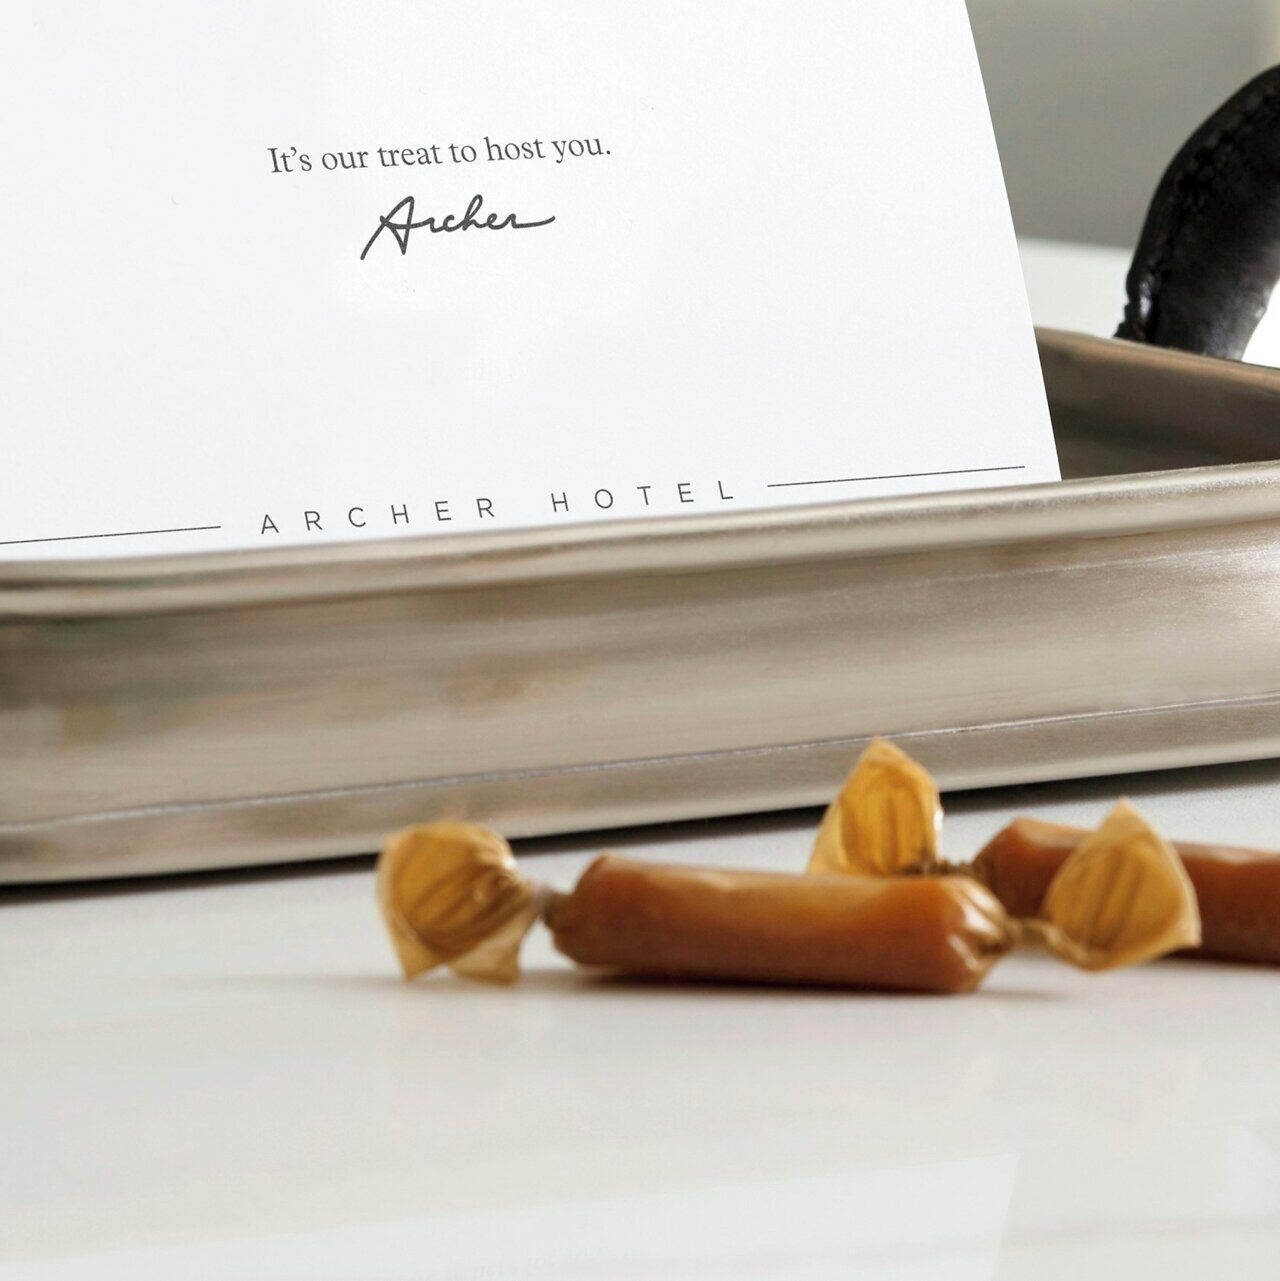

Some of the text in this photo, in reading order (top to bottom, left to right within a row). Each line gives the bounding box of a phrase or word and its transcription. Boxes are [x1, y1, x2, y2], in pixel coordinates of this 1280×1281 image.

[322, 152, 369, 170] our
[376, 144, 443, 168] treat
[448, 144, 477, 163] to
[483, 136, 547, 162] host
[551, 139, 612, 163] you.
[360, 193, 556, 261] Archer
[260, 480, 734, 535] ARCHER HOTEL
